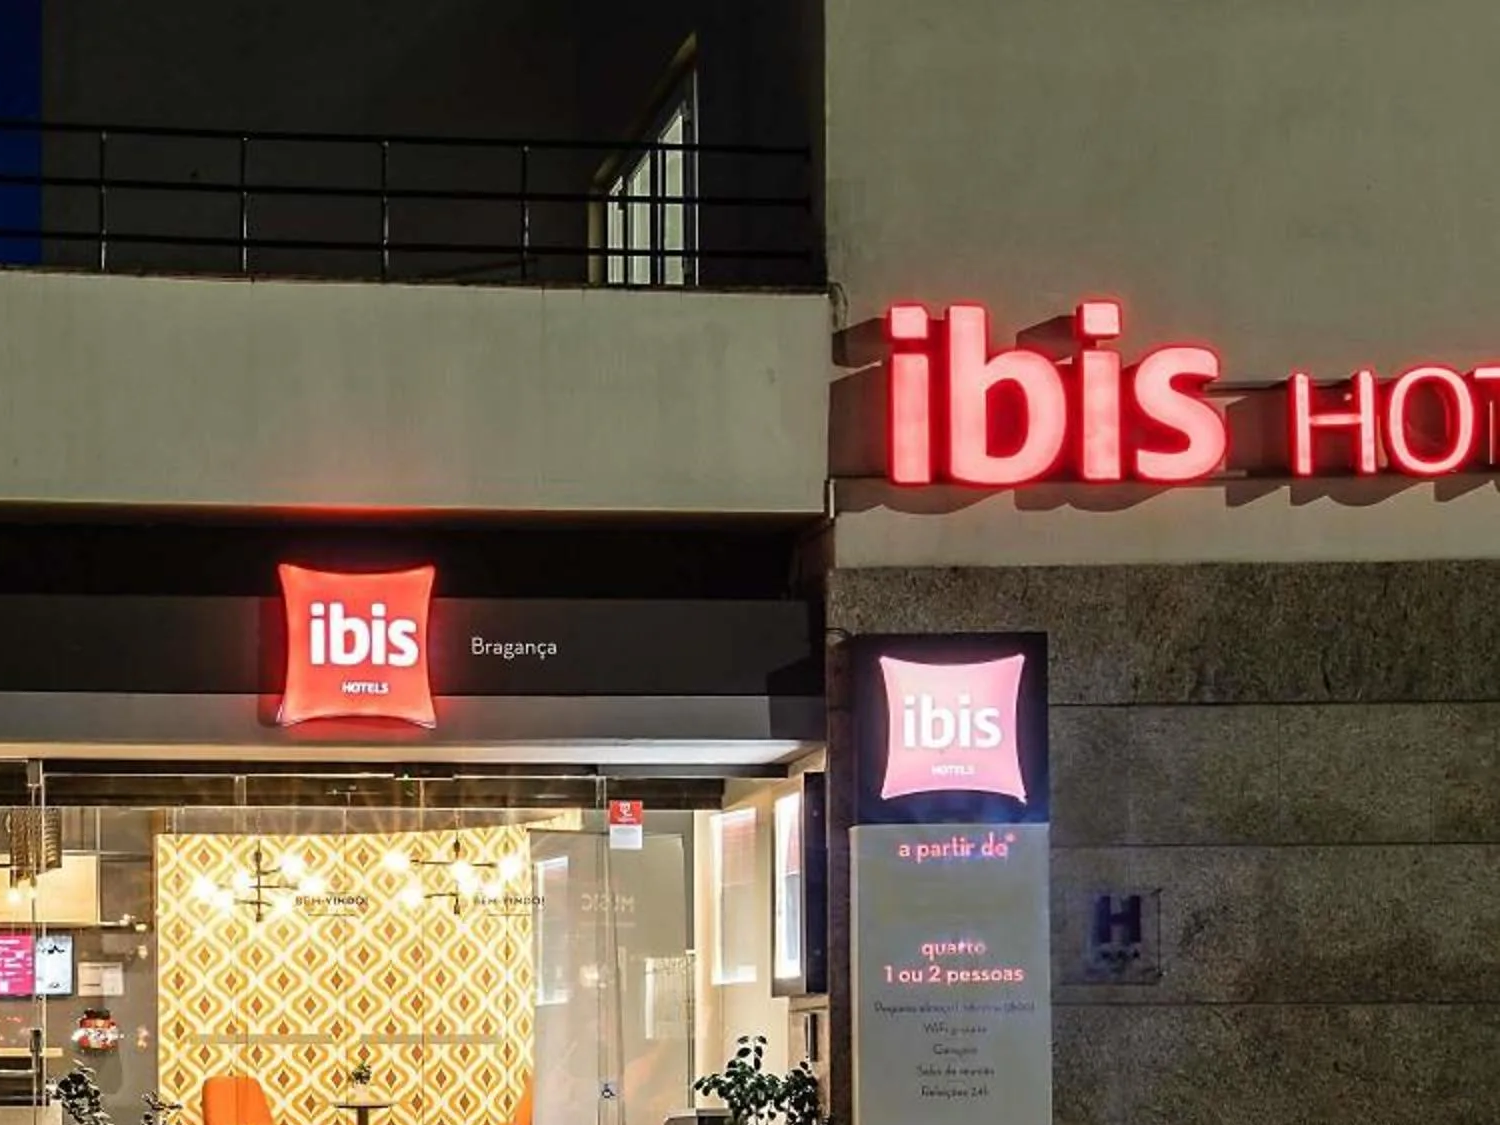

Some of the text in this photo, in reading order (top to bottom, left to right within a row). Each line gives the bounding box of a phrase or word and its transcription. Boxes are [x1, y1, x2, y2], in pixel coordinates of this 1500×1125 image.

[889, 301, 1227, 483] ibis
[310, 602, 419, 666] ibis
[471, 636, 558, 660] Bragança
[341, 681, 389, 694] HOTELS
[903, 693, 1003, 750] ibis
[899, 843, 911, 857] a
[917, 836, 976, 864] partir
[885, 965, 1024, 986] 1 ou 2 pessoas
